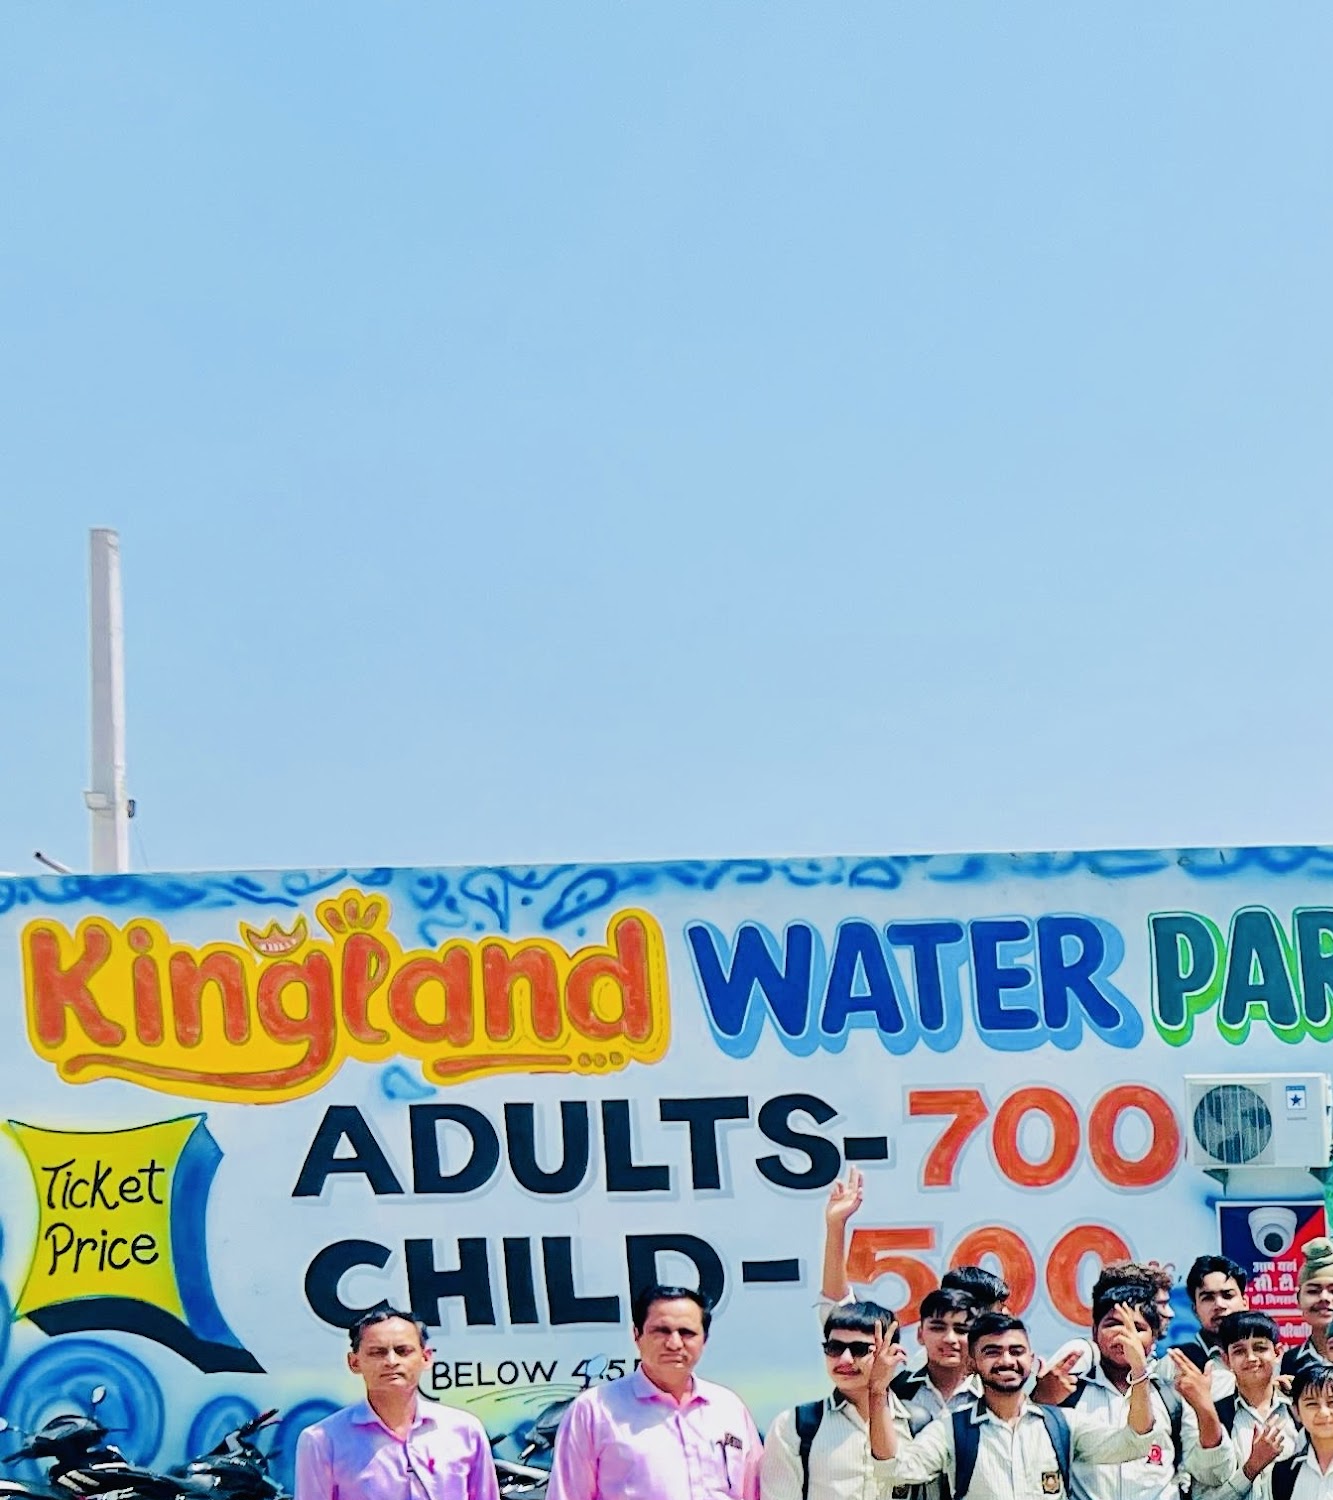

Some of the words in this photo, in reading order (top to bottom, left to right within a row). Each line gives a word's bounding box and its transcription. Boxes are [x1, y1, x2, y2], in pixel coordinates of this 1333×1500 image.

[26, 908, 656, 1094] Kingland
[684, 914, 1128, 1042] WATER
[45, 1222, 159, 1276] Price
